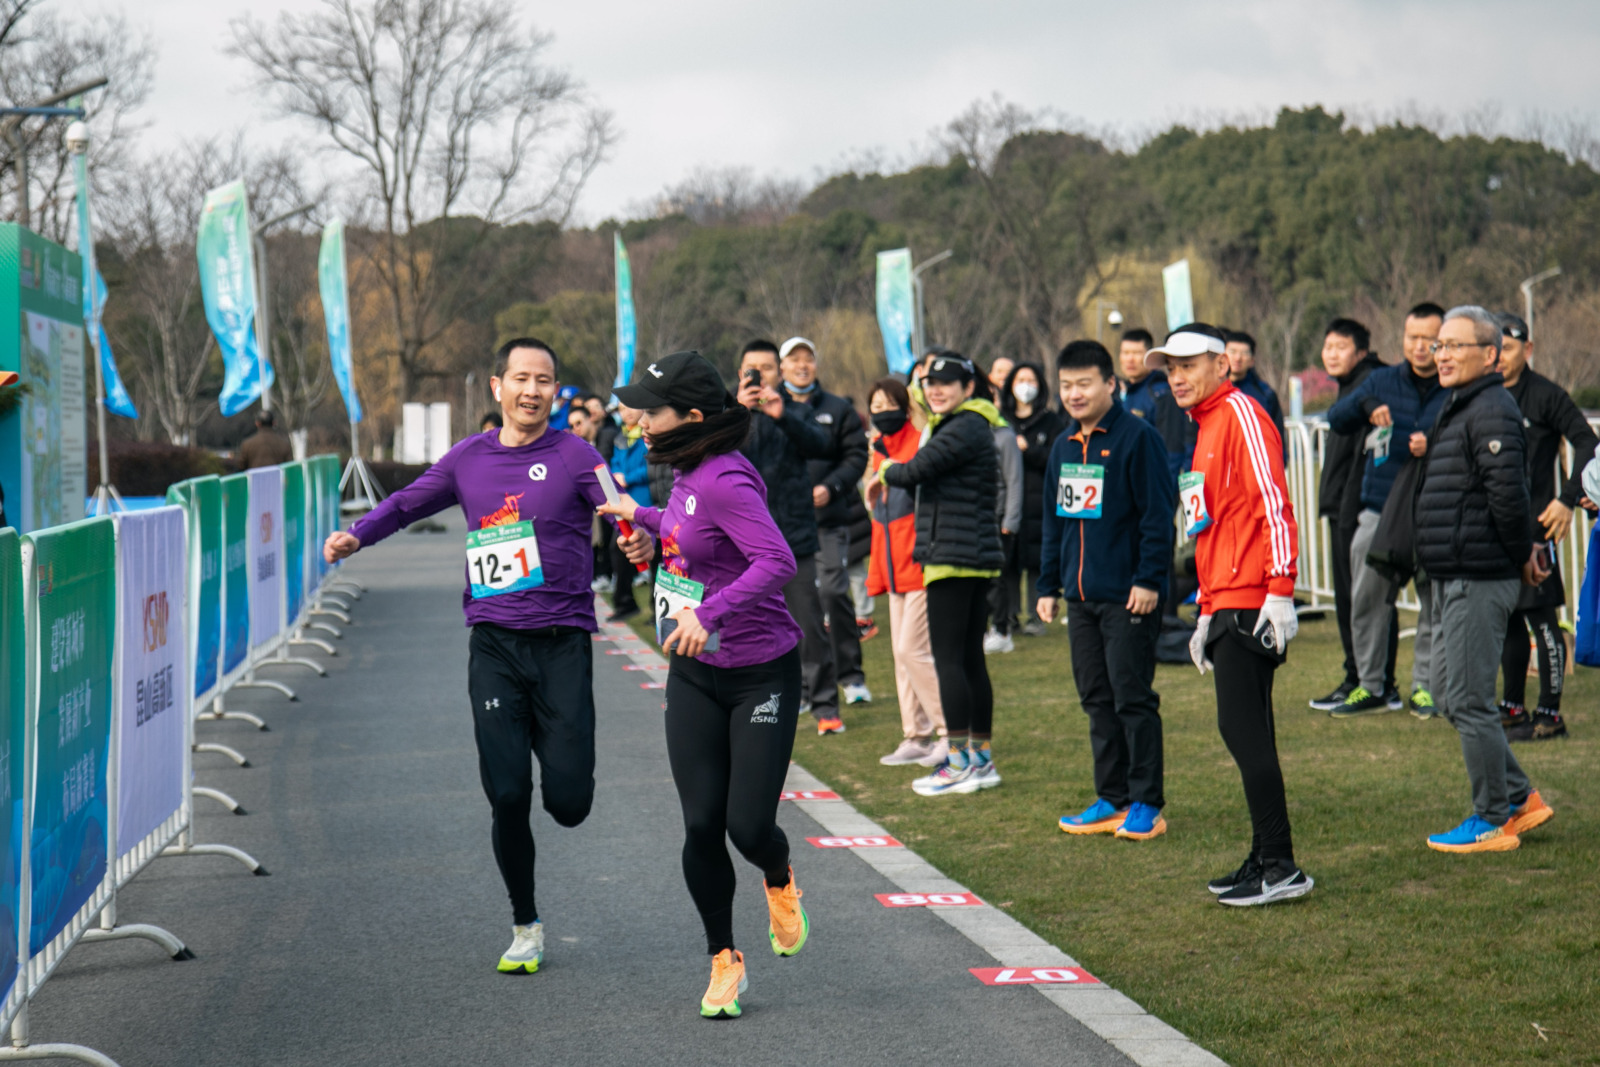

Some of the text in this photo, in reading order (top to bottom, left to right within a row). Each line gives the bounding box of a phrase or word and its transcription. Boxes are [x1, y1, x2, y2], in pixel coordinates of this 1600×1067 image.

[474, 547, 530, 585] 12-1
[136, 664, 173, 727] 昆山高新区
[750, 715, 778, 724] KSND
[818, 837, 888, 847] 09
[887, 894, 967, 905] 08
[994, 968, 1079, 985] 07
